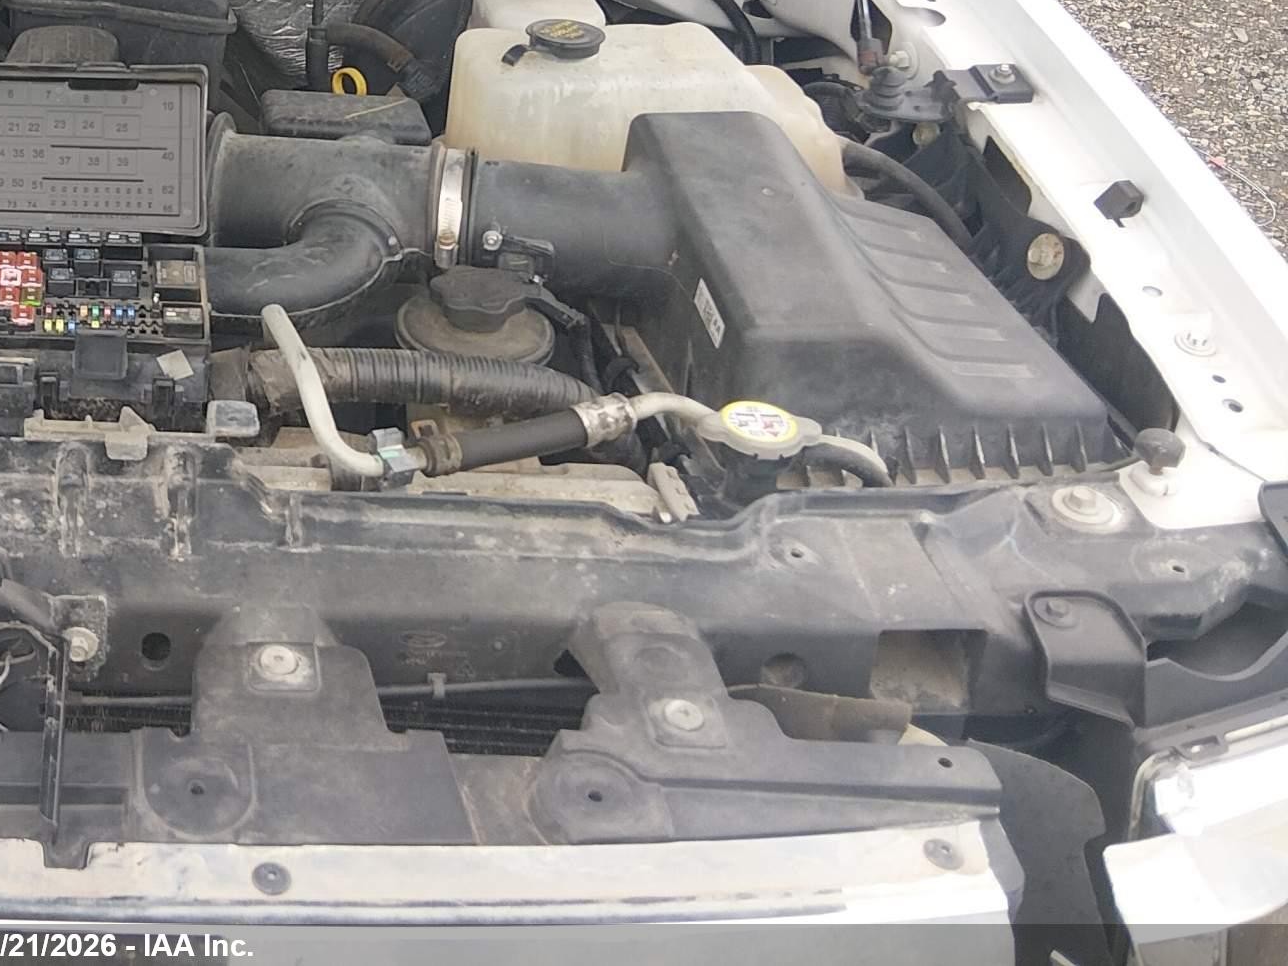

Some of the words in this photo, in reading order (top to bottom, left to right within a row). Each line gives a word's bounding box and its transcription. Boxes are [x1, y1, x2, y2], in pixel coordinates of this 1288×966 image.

[162, 102, 174, 110] 10
[8, 123, 20, 131] 21
[28, 123, 40, 132] 22
[54, 120, 66, 129] 23
[82, 121, 94, 129] 24
[116, 123, 128, 132] 25
[13, 149, 24, 158] 35
[58, 156, 71, 165] 37
[162, 152, 174, 160] 40
[12, 178, 24, 187] 50
[32, 181, 44, 190] 51
